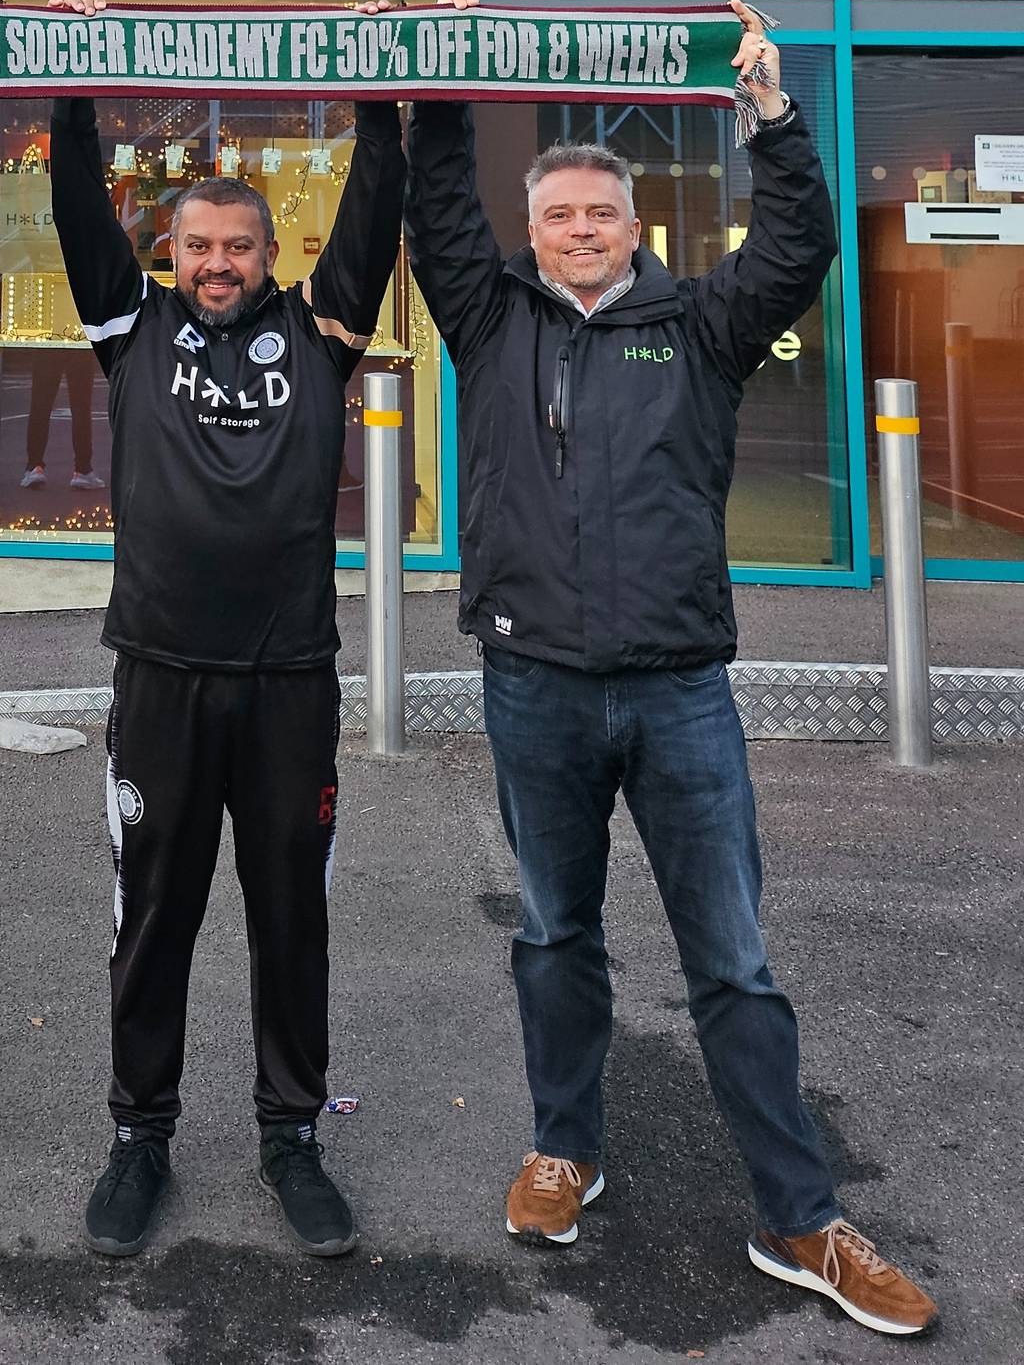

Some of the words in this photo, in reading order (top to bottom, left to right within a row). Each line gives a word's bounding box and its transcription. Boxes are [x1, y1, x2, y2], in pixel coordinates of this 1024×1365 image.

[6, 18, 127, 75] SOCCER
[134, 21, 283, 78] ACADEMY
[290, 22, 327, 78] FC
[336, 20, 408, 78] 50%
[417, 19, 471, 77] OFF
[477, 20, 540, 78] FOR
[548, 23, 570, 80] 8
[577, 23, 690, 84] WEEKS
[198, 414, 218, 425] Self
[220, 417, 260, 428] Storage
